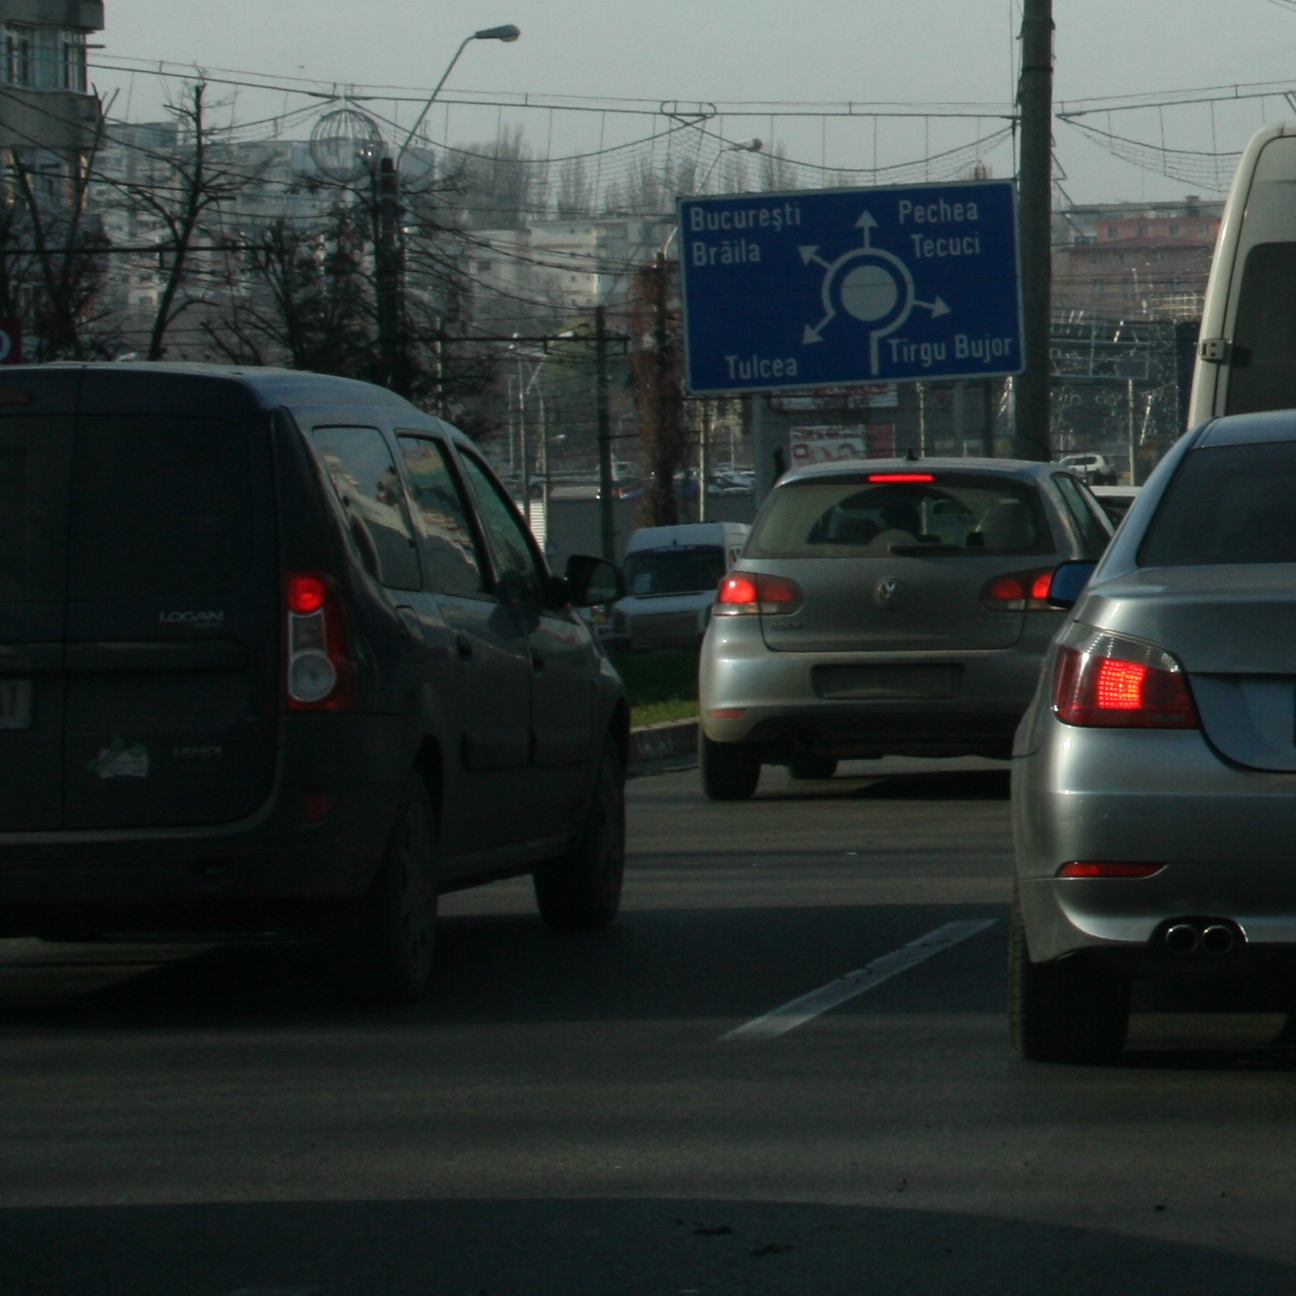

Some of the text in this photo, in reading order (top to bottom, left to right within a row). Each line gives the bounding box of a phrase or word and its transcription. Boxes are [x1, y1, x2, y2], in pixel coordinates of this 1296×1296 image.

[898, 198, 978, 224] Pechea
[692, 238, 761, 266] Brăila
[911, 231, 980, 259] Tecuci
[954, 333, 1012, 363] Bujor
[725, 355, 798, 380] Tulcea
[159, 609, 224, 623] LOGAN
